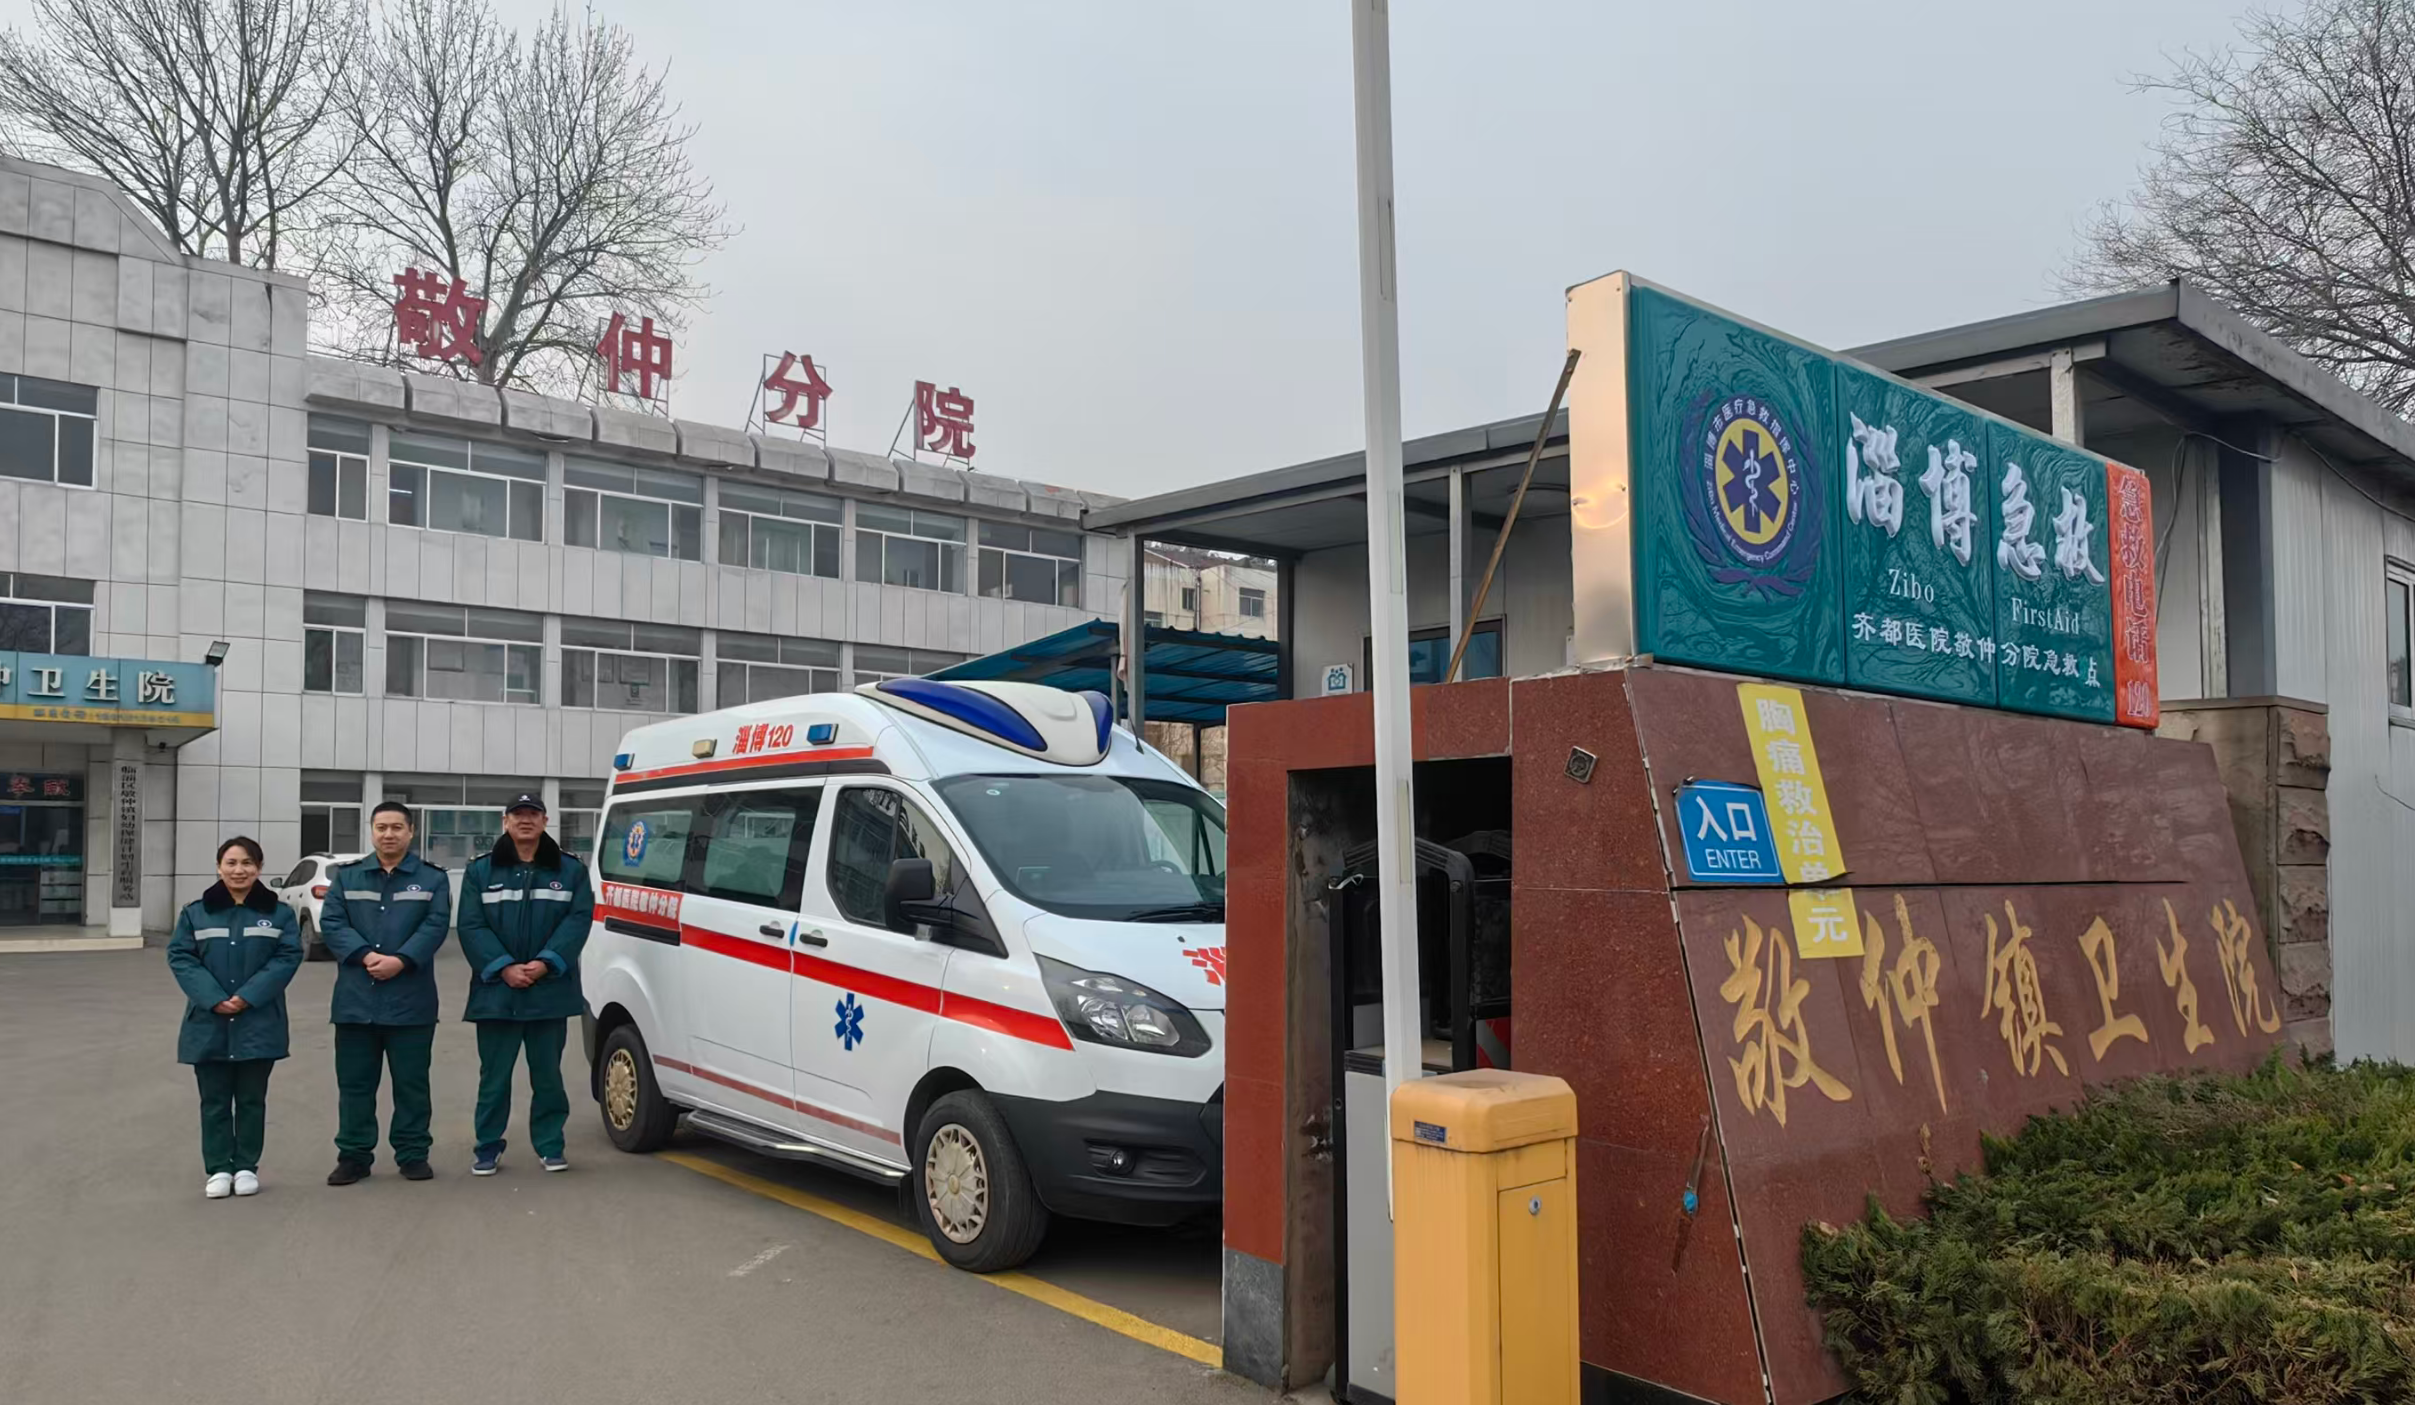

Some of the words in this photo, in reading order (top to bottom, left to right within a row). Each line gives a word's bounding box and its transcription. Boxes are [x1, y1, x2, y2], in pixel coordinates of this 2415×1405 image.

[393, 267, 976, 459] 敬仲分院
[1846, 411, 2105, 584] 淄博急救
[1711, 505, 1733, 544] Medical
[1730, 538, 1765, 564] Emergency
[1764, 532, 1791, 561] Command
[1888, 567, 1935, 604] Zibo
[2011, 596, 2081, 636] FirstAid
[1851, 611, 2102, 689] 齐都医院敬仲分院急救点
[2126, 680, 2150, 718] 120
[1697, 796, 1757, 843] 入口
[1755, 698, 1849, 943] 胸痛救治单元
[1705, 848, 1763, 870] ENTER
[1720, 894, 2281, 1128] 敬仲镇卫生院
